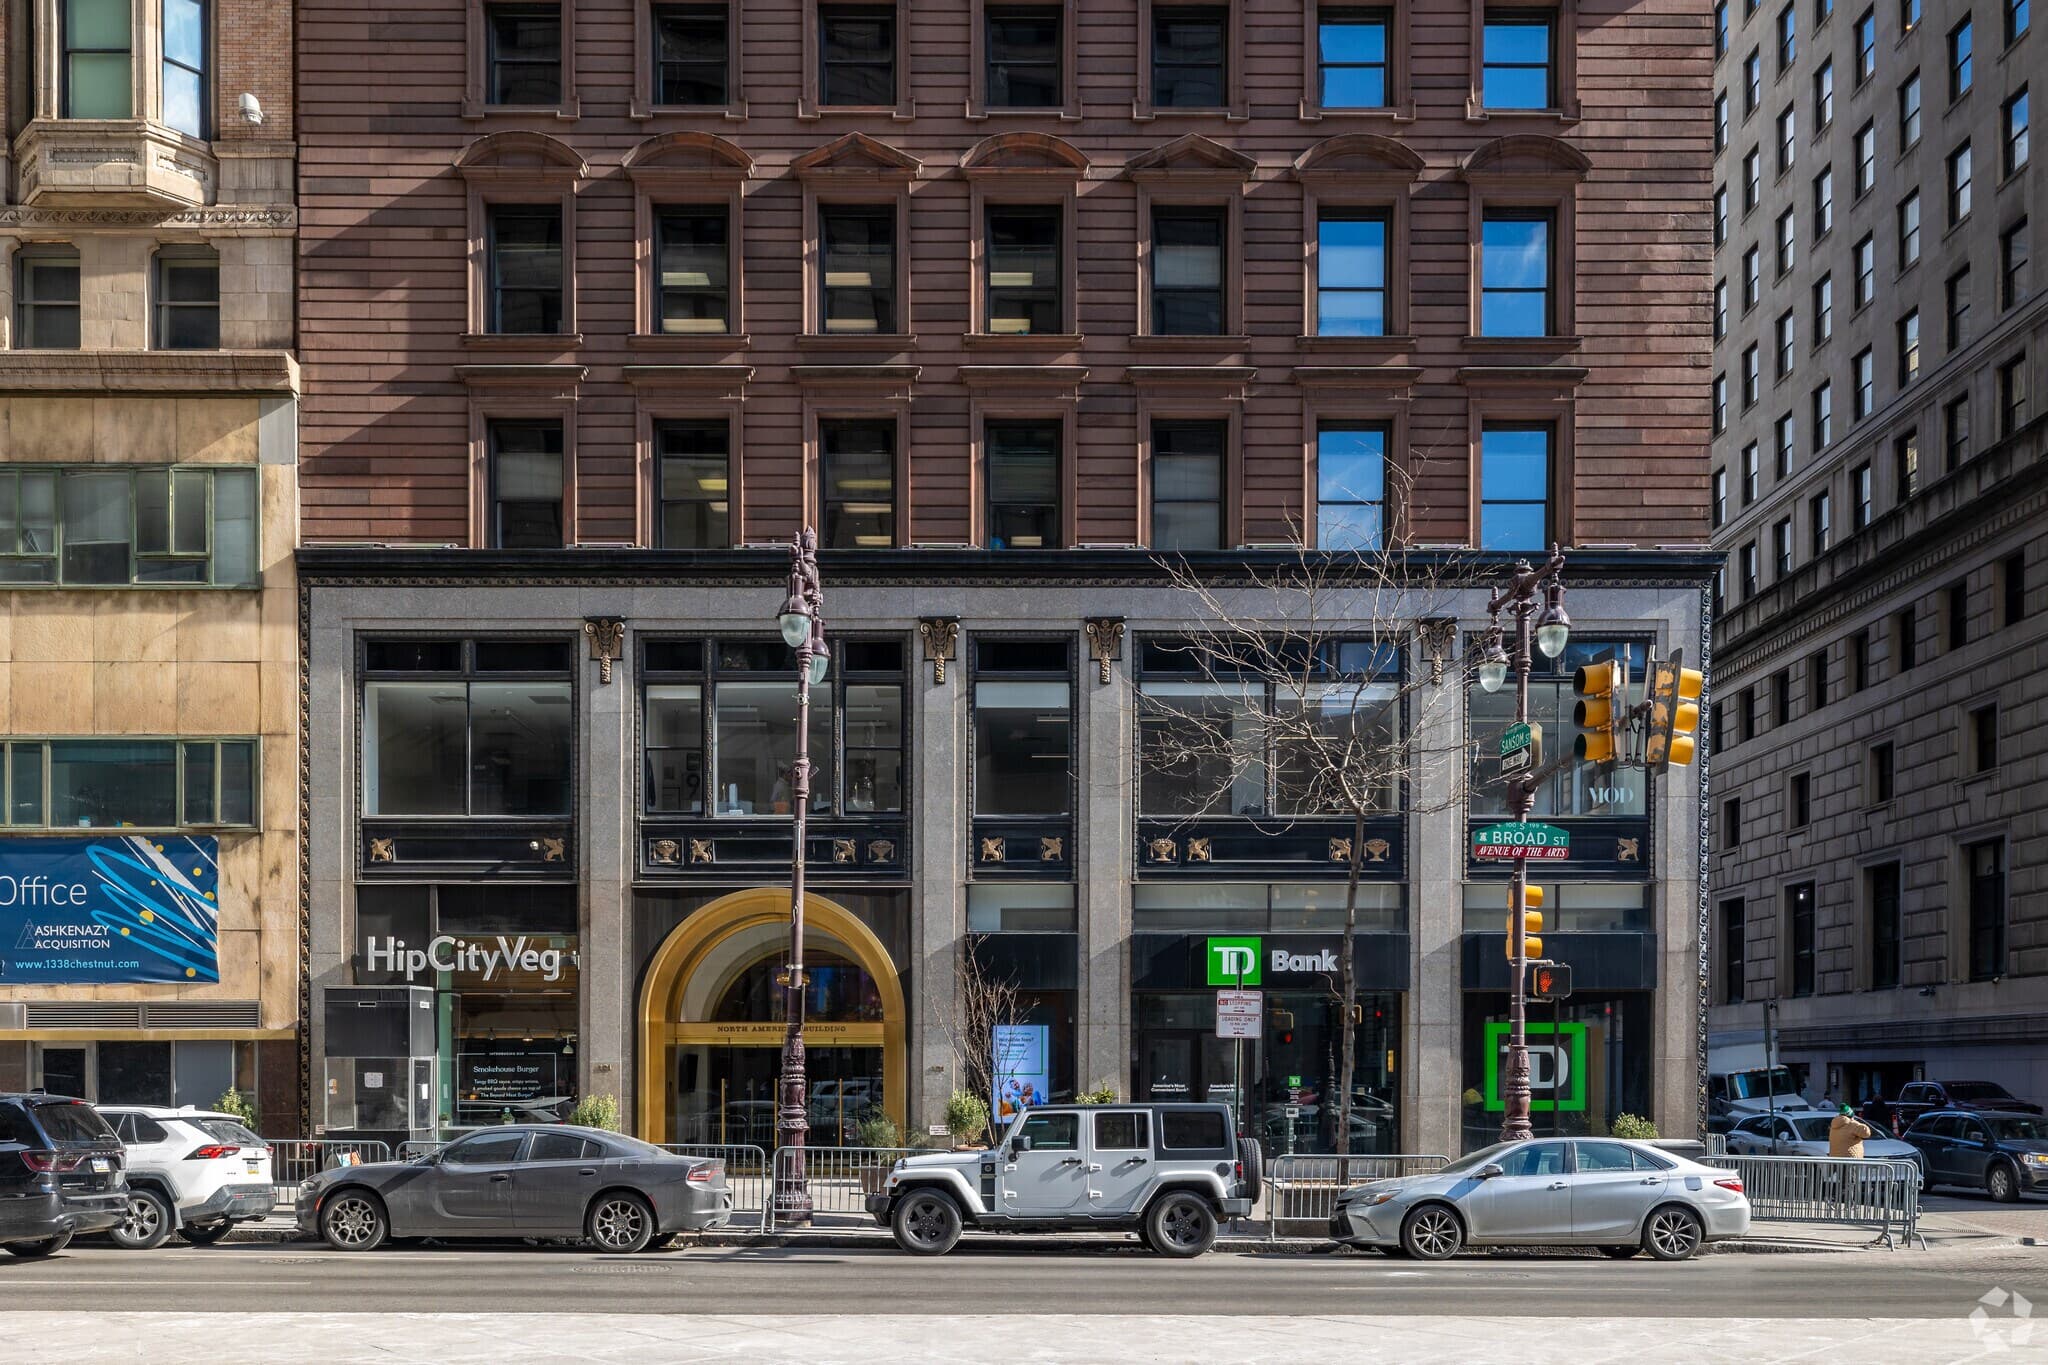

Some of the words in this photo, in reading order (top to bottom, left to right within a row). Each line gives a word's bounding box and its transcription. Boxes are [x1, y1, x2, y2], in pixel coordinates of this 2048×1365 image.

[1501, 732, 1524, 753] SANSOM
[1492, 831, 1547, 845] BROAD
[1553, 836, 1566, 846] ST
[1477, 845, 1511, 856] AVENUE
[1512, 846, 1524, 856] OF
[1526, 847, 1543, 857] THE
[1545, 847, 1567, 857] ARTS
[0, 875, 88, 906] Office
[34, 924, 110, 937] ASHKENAZY
[34, 939, 110, 950] ACQUISITION
[15, 959, 140, 969] www.1338chestnut.com
[367, 935, 560, 982] HipCityVeg
[1213, 946, 1256, 976] TD
[1271, 948, 1339, 972] Bank
[473, 1065, 515, 1073] Smokehouse
[516, 1065, 540, 1074] Burger
